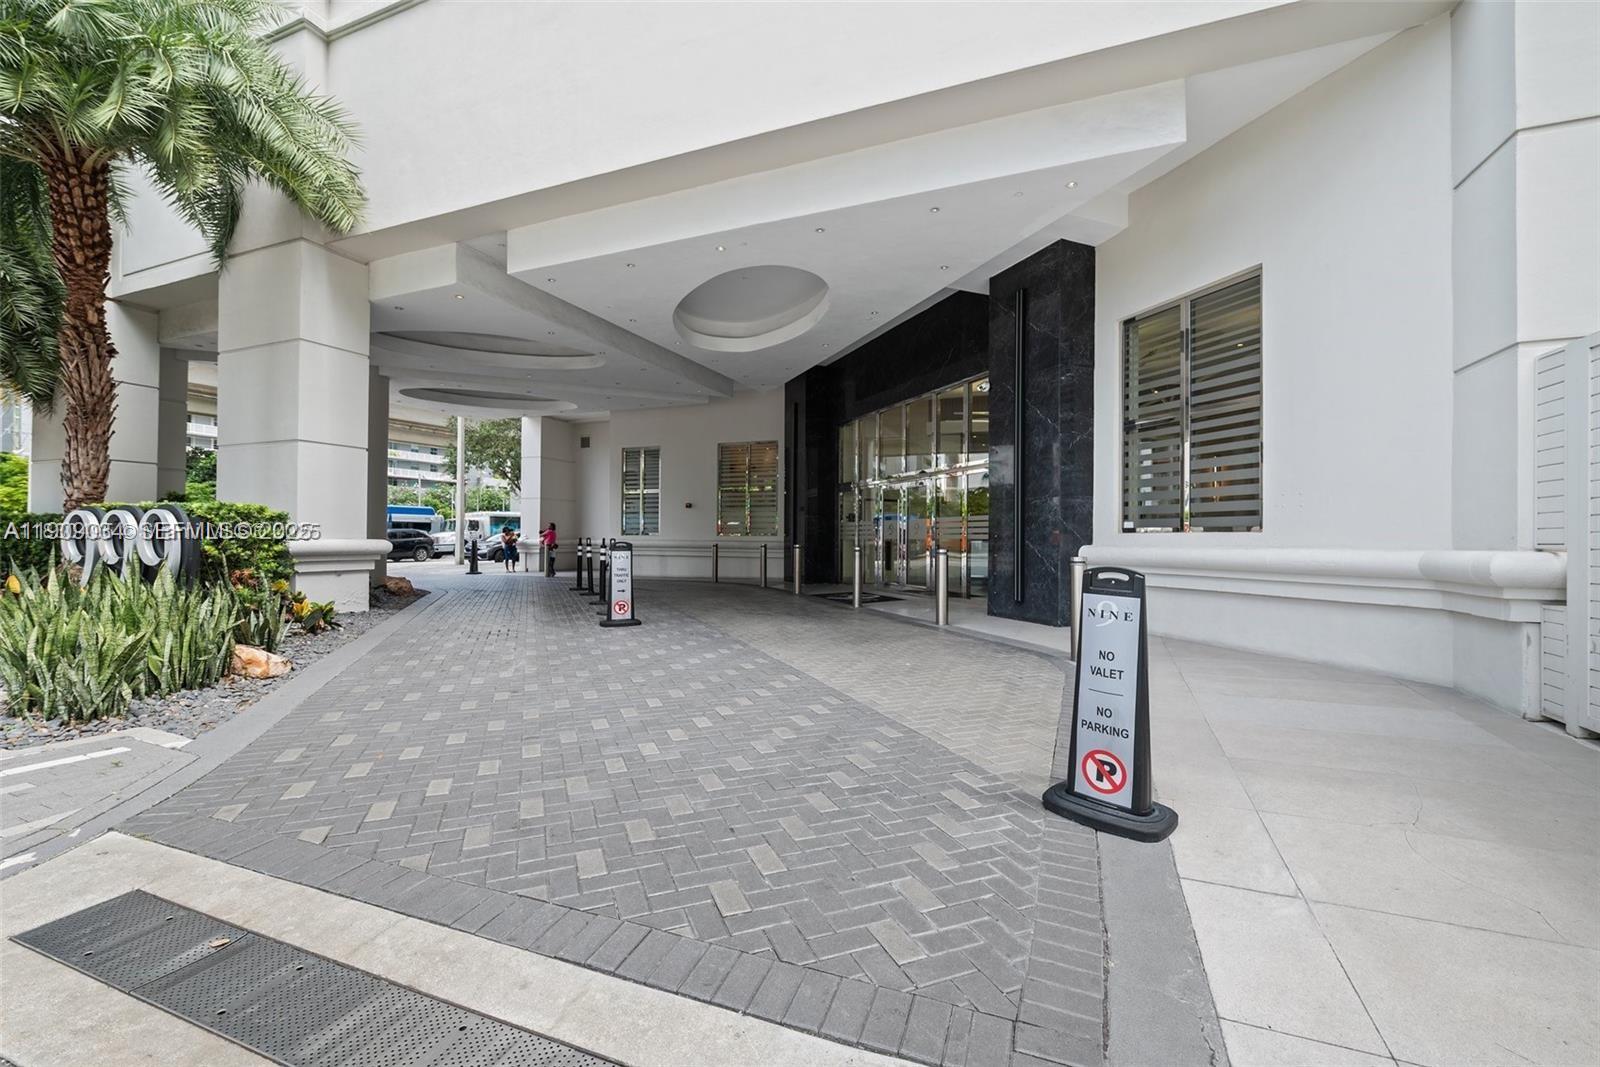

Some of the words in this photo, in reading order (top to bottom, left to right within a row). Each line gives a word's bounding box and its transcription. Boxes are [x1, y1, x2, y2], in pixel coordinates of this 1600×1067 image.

[1087, 607, 1134, 622] NINE
[1098, 649, 1115, 662] NO
[1089, 665, 1125, 681] VALET
[1096, 705, 1113, 719] NO
[1081, 719, 1130, 739] PARKING
